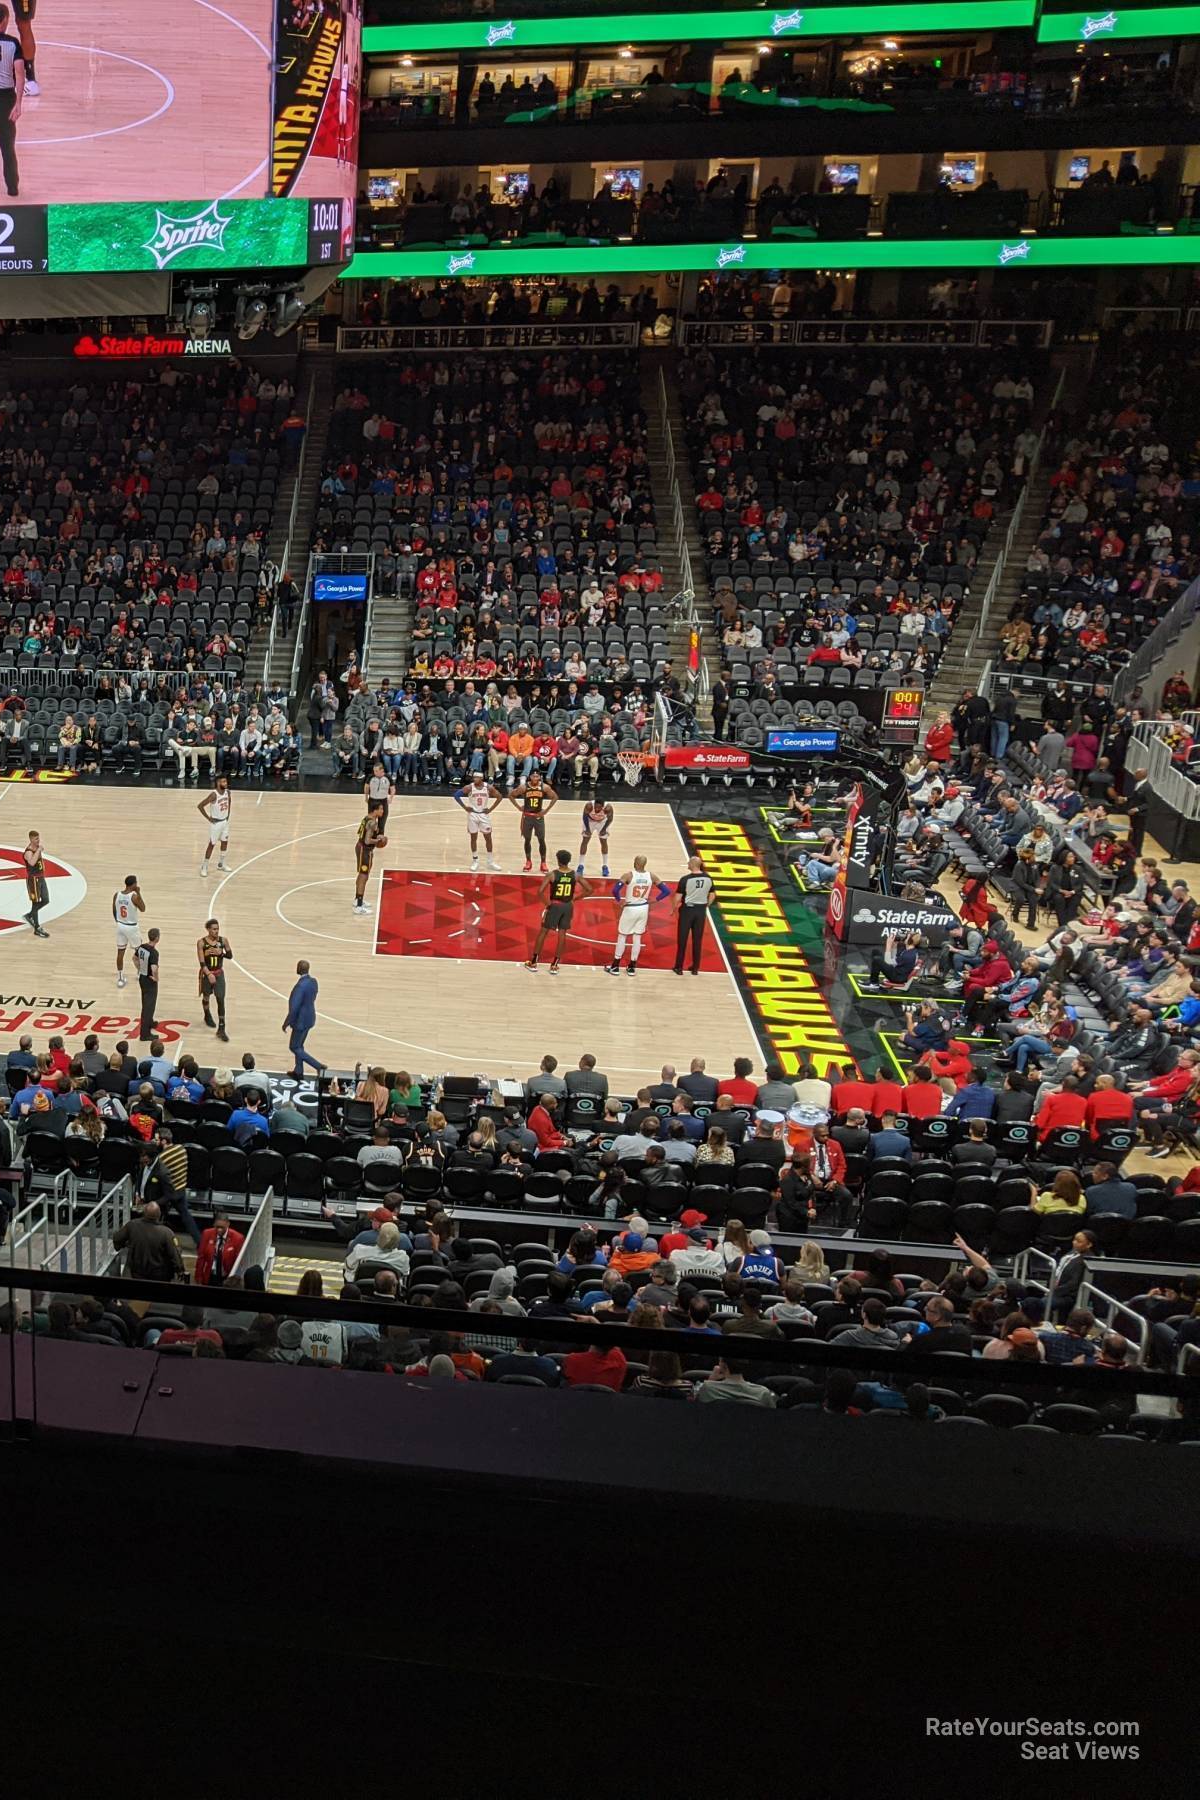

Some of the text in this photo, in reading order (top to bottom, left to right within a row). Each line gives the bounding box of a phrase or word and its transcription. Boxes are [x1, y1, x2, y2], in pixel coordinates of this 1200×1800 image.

[313, 203, 339, 231] 10:01
[155, 219, 221, 250] Sprite
[320, 242, 331, 259] 1ST
[42, 259, 48, 269] 7
[184, 339, 232, 354] ARENA
[326, 585, 348, 593] Georgia
[894, 692, 919, 703] 10:01
[894, 702, 913, 716] 24
[783, 737, 836, 747] Georgia Power
[850, 815, 874, 868] xfinity
[555, 883, 572, 897] 30
[695, 879, 705, 889] 37
[632, 886, 649, 899] 67
[119, 906, 128, 919] 6
[684, 819, 865, 1082] ATLANTA HAWKS
[211, 956, 218, 967] 11
[744, 1264, 774, 1277] FRAZIER
[310, 1345, 329, 1360] 11
